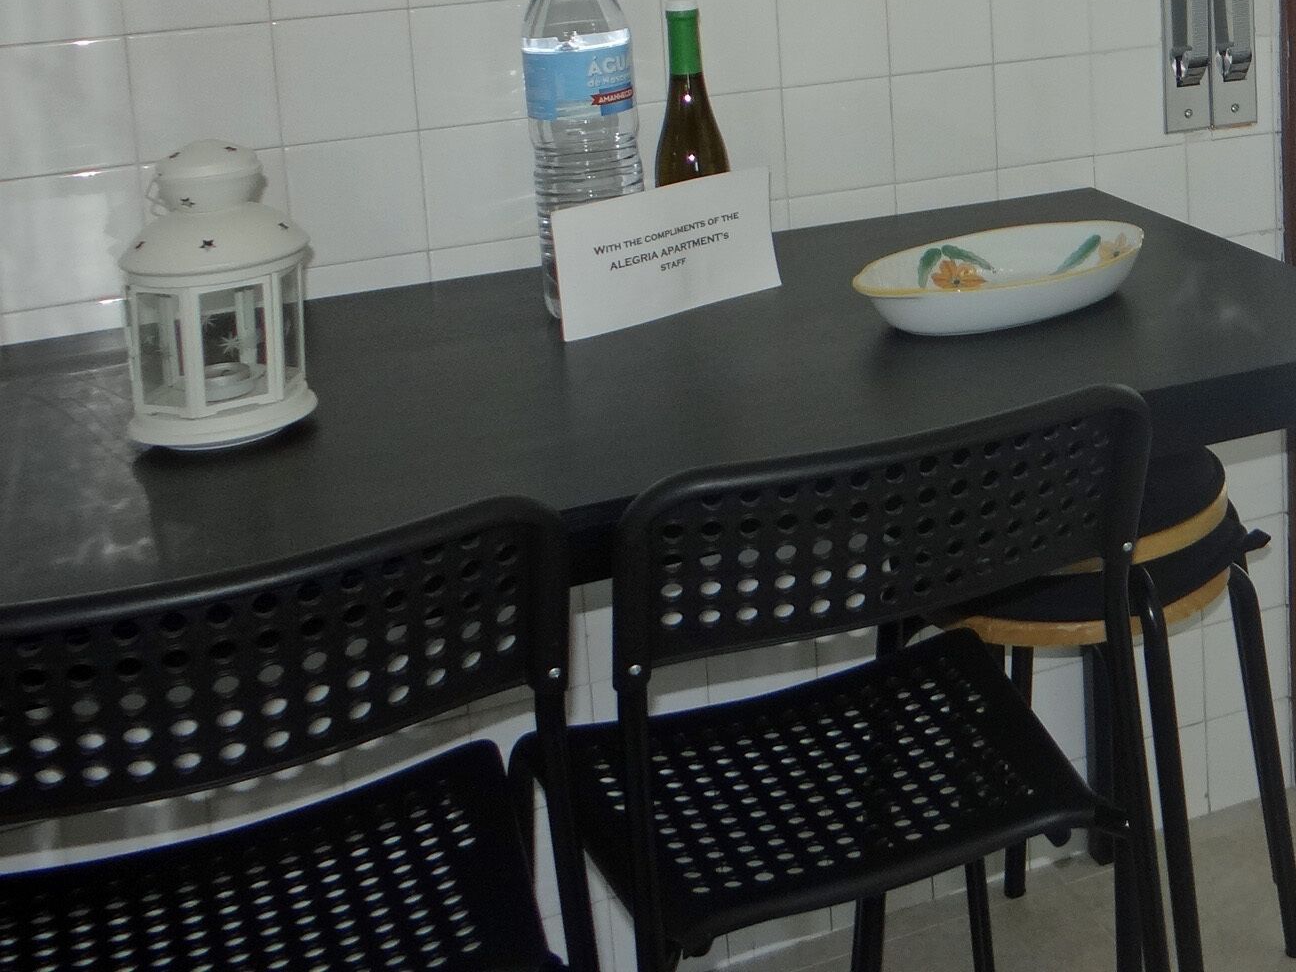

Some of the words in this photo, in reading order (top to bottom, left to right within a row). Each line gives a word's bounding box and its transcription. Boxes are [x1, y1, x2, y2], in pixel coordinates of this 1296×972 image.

[593, 242, 622, 256] WITH
[623, 236, 643, 249] THE
[644, 220, 706, 244] COMPLIMENTS
[707, 216, 720, 226] OF
[721, 212, 739, 223] THE
[609, 251, 659, 271] ALEGRIA
[660, 258, 687, 272] STAFF
